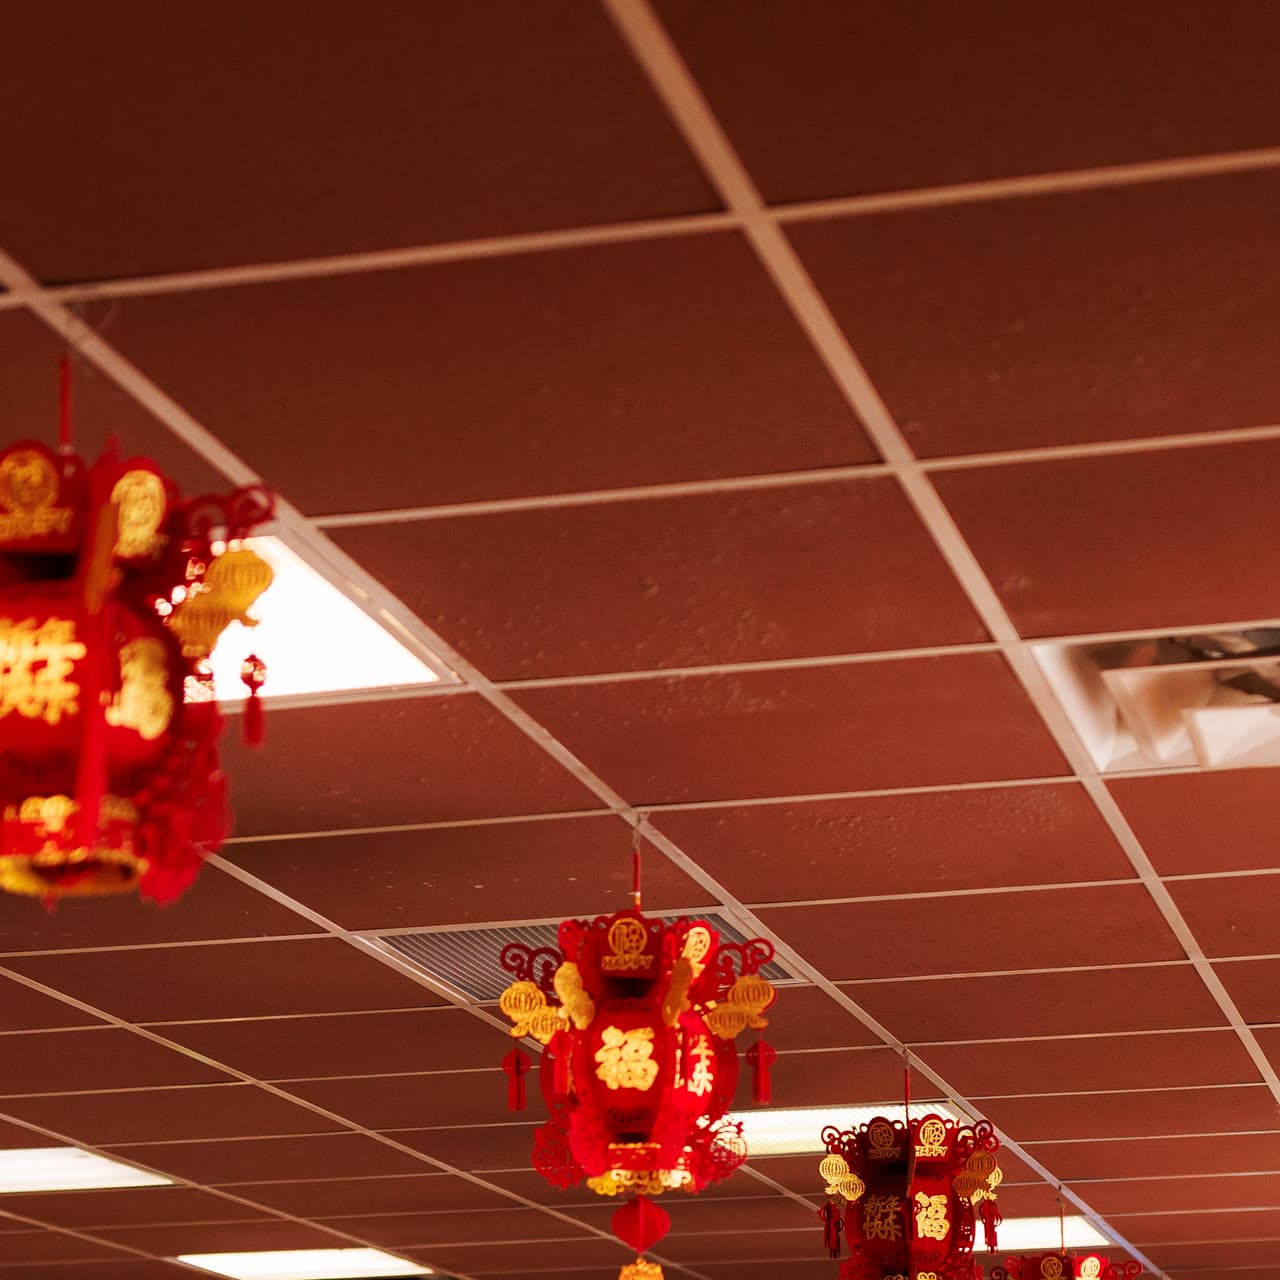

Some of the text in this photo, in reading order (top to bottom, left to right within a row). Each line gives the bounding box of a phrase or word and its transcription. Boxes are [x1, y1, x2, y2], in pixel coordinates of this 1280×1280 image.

[601, 955, 654, 970] HAPPY
[595, 1026, 659, 1091] 福
[920, 1120, 946, 1147] 福
[863, 1195, 901, 1217] 新年
[913, 1191, 950, 1241] 福
[863, 1214, 902, 1242] 快乐
